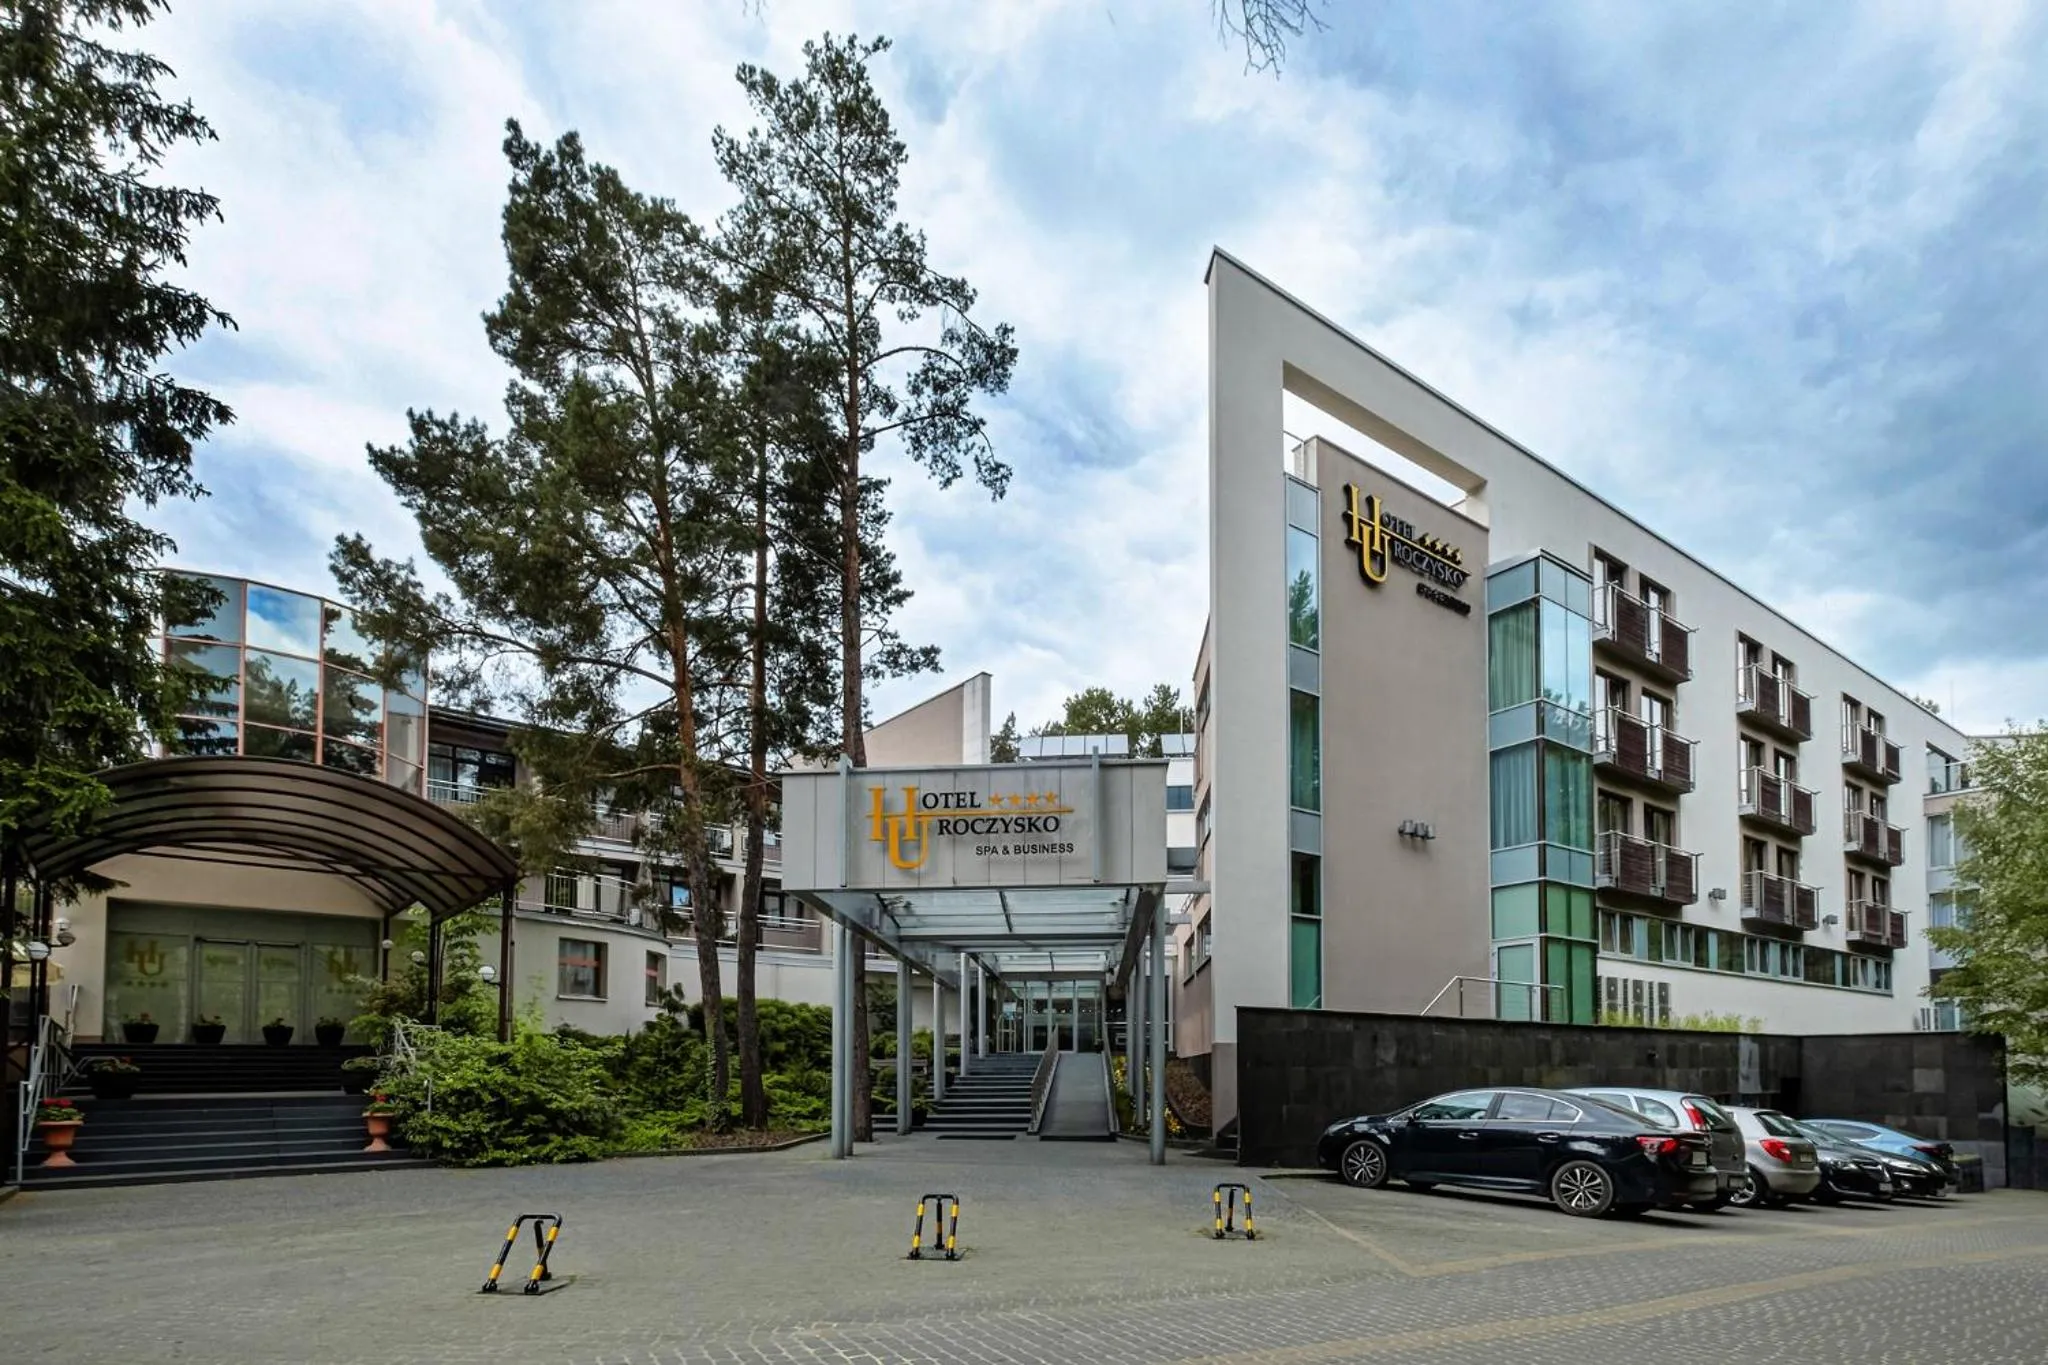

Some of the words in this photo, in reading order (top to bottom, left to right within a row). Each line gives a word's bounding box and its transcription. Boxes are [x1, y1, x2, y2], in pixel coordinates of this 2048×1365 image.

[975, 845, 999, 856] SPA
[1002, 845, 1010, 855] &
[1014, 842, 1075, 855] BUSINESS
